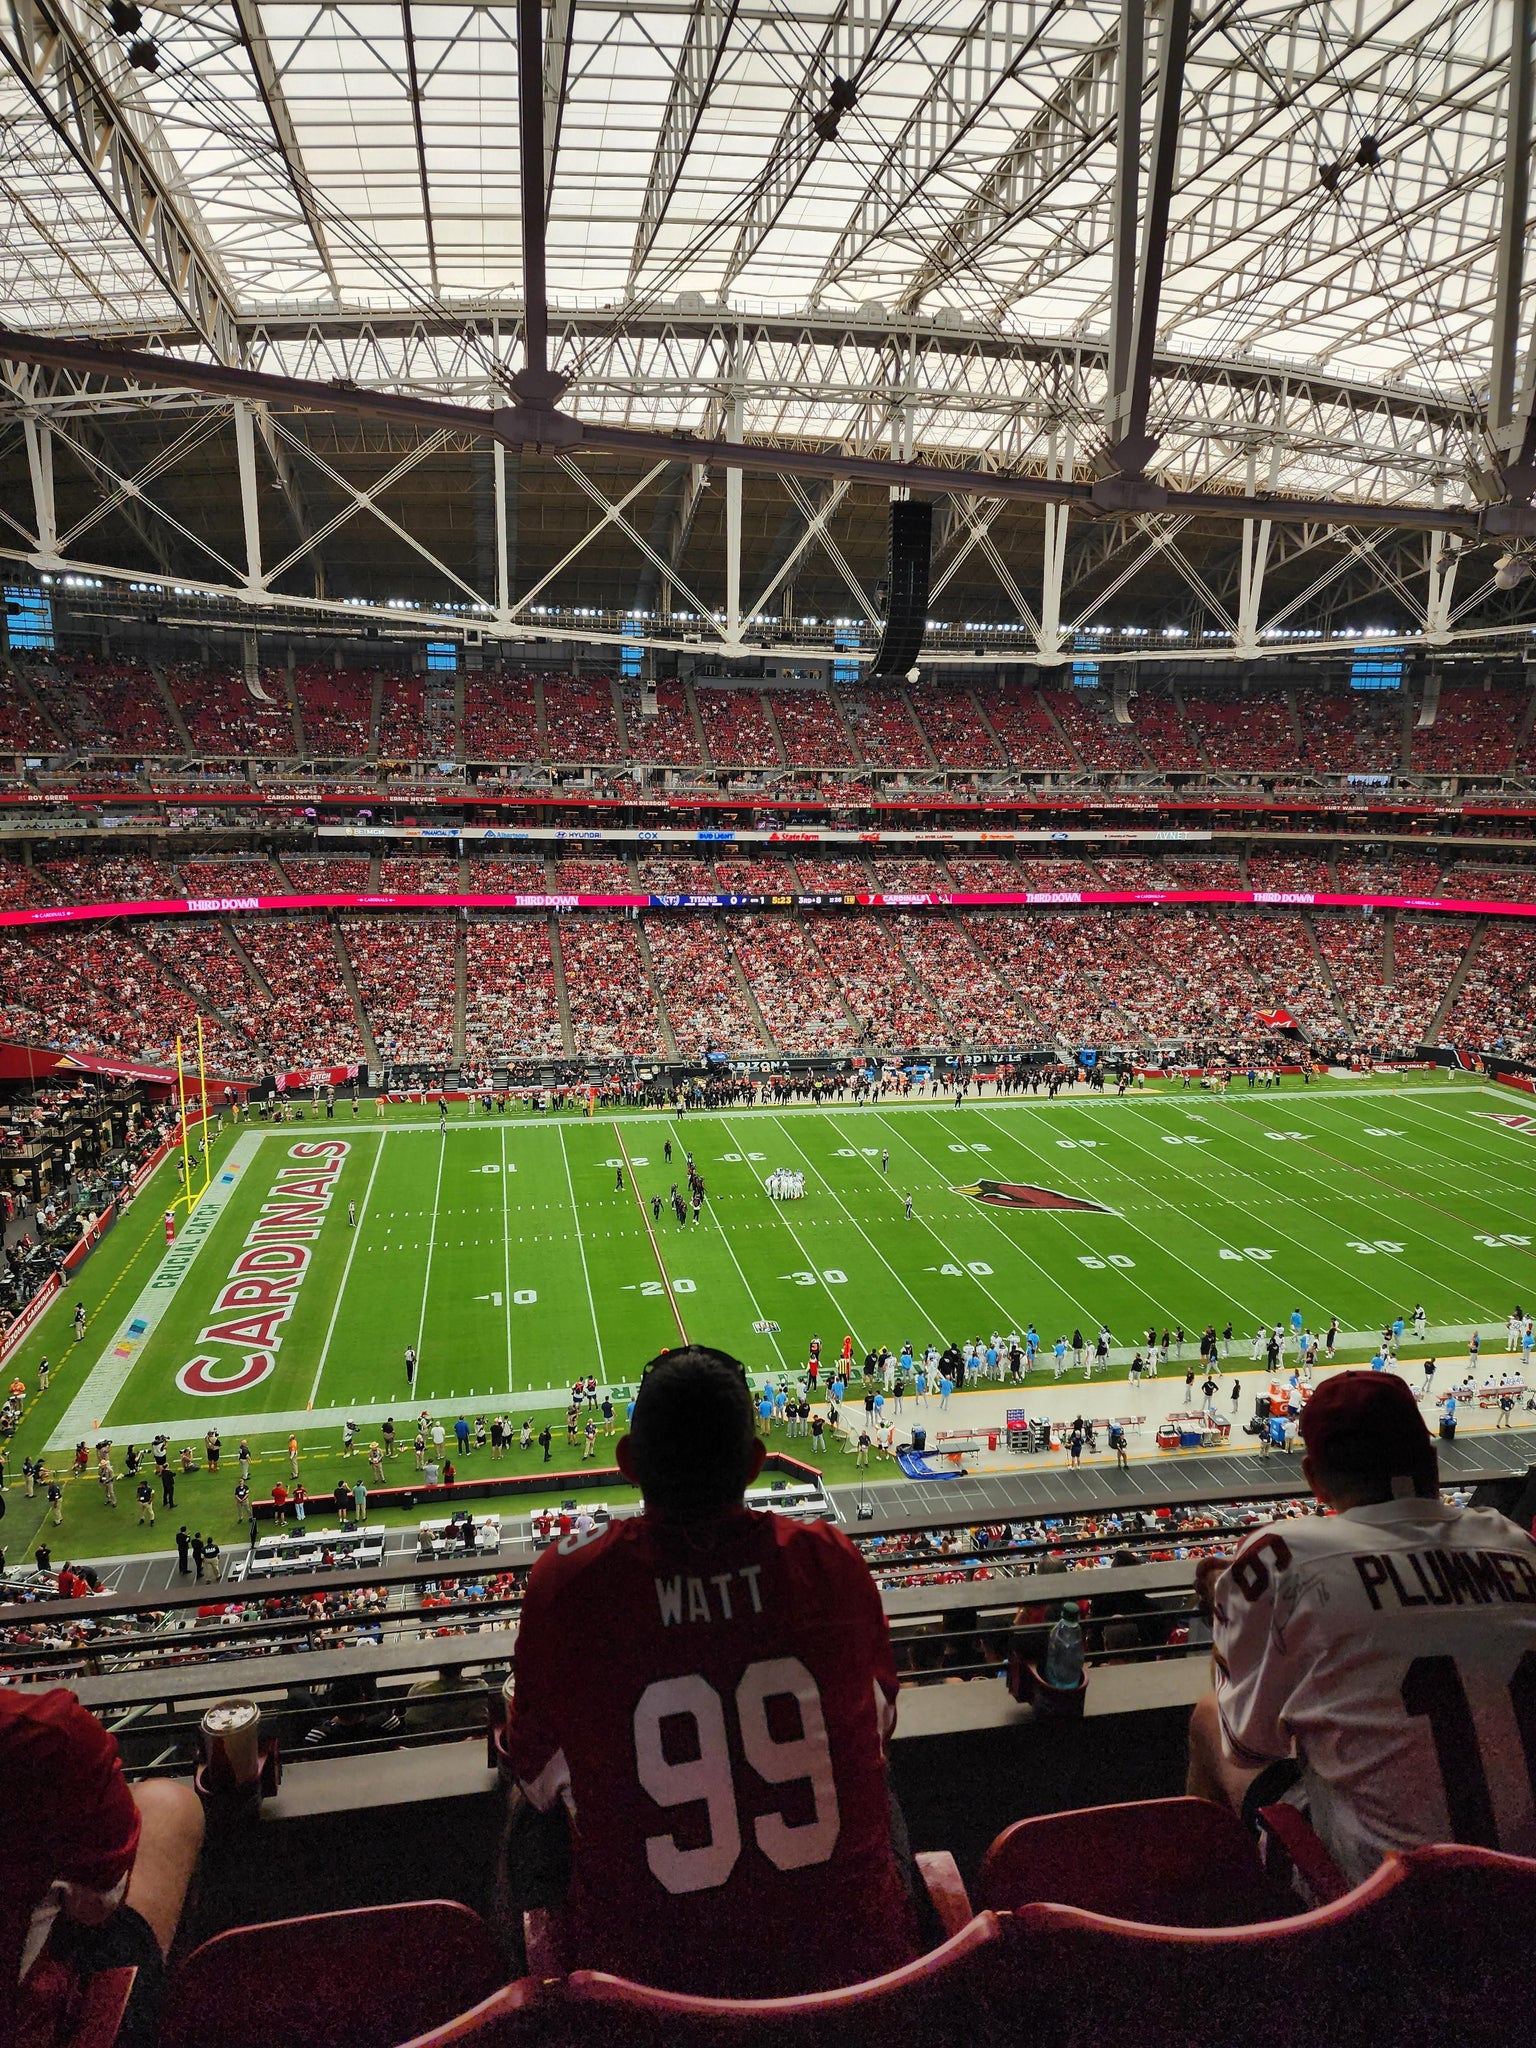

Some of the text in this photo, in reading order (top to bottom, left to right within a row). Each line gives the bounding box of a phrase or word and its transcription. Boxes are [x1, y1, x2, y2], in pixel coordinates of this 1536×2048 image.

[1154, 832, 1189, 840] AVNET
[187, 898, 259, 911] THIRD DOWN
[515, 896, 579, 906] THIRD DOWN
[730, 896, 738, 904] 0
[1026, 893, 1082, 902] THIRD DOWN
[1254, 893, 1314, 904] THIRD DOWN
[97, 1066, 172, 1080] verizon
[310, 1072, 331, 1081] CATCH
[837, 1148, 879, 1157] 40
[948, 1144, 992, 1152] 50
[605, 1158, 650, 1168] 20
[722, 1152, 767, 1162] 30
[481, 1164, 518, 1174] 10
[151, 1204, 222, 1289] CRUCIAL CATCH
[1346, 1240, 1404, 1254] 30
[1472, 1234, 1532, 1248] 20
[1076, 1254, 1136, 1269] 50
[1219, 1248, 1273, 1262] 40
[175, 1141, 352, 1397] CARDINALS
[940, 1262, 994, 1277] 40
[791, 1270, 849, 1286] 30
[640, 1279, 697, 1296] 20
[490, 1290, 538, 1306] 10
[0, 1282, 55, 1357] ARIZONA CARDINALS
[655, 1565, 763, 1628] WATT
[633, 1656, 841, 1895] 99
